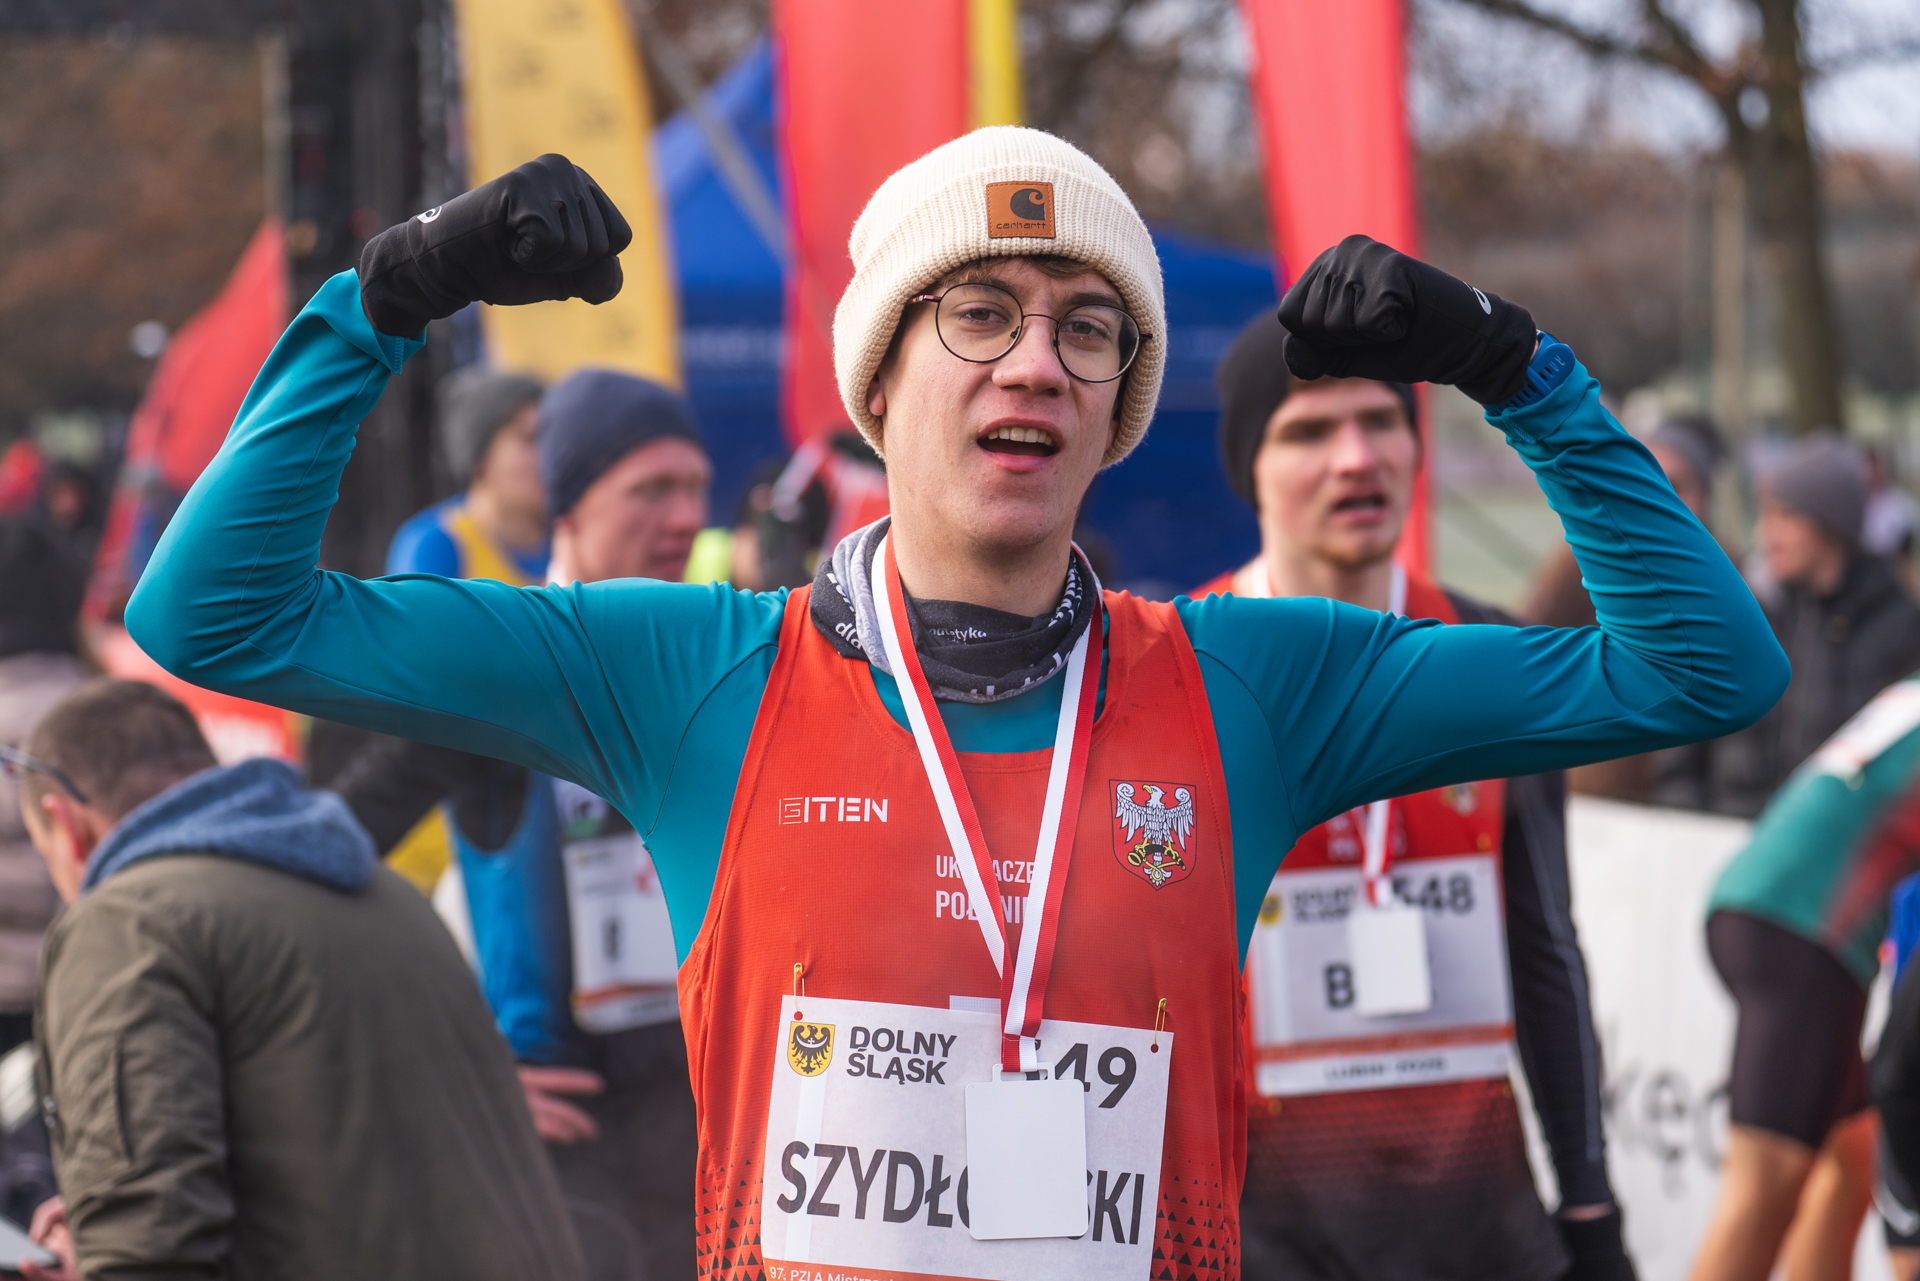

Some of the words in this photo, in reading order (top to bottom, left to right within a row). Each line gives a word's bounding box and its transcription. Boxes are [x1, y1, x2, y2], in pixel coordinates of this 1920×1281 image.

[995, 221, 1047, 230] carhartt
[849, 1026, 958, 1058] DOLNY
[846, 1048, 948, 1085] ŚLĄSK
[1025, 1039, 1137, 1109] 49
[776, 1140, 1145, 1245] SZYDŁKI
[769, 1266, 786, 1281] 97.
